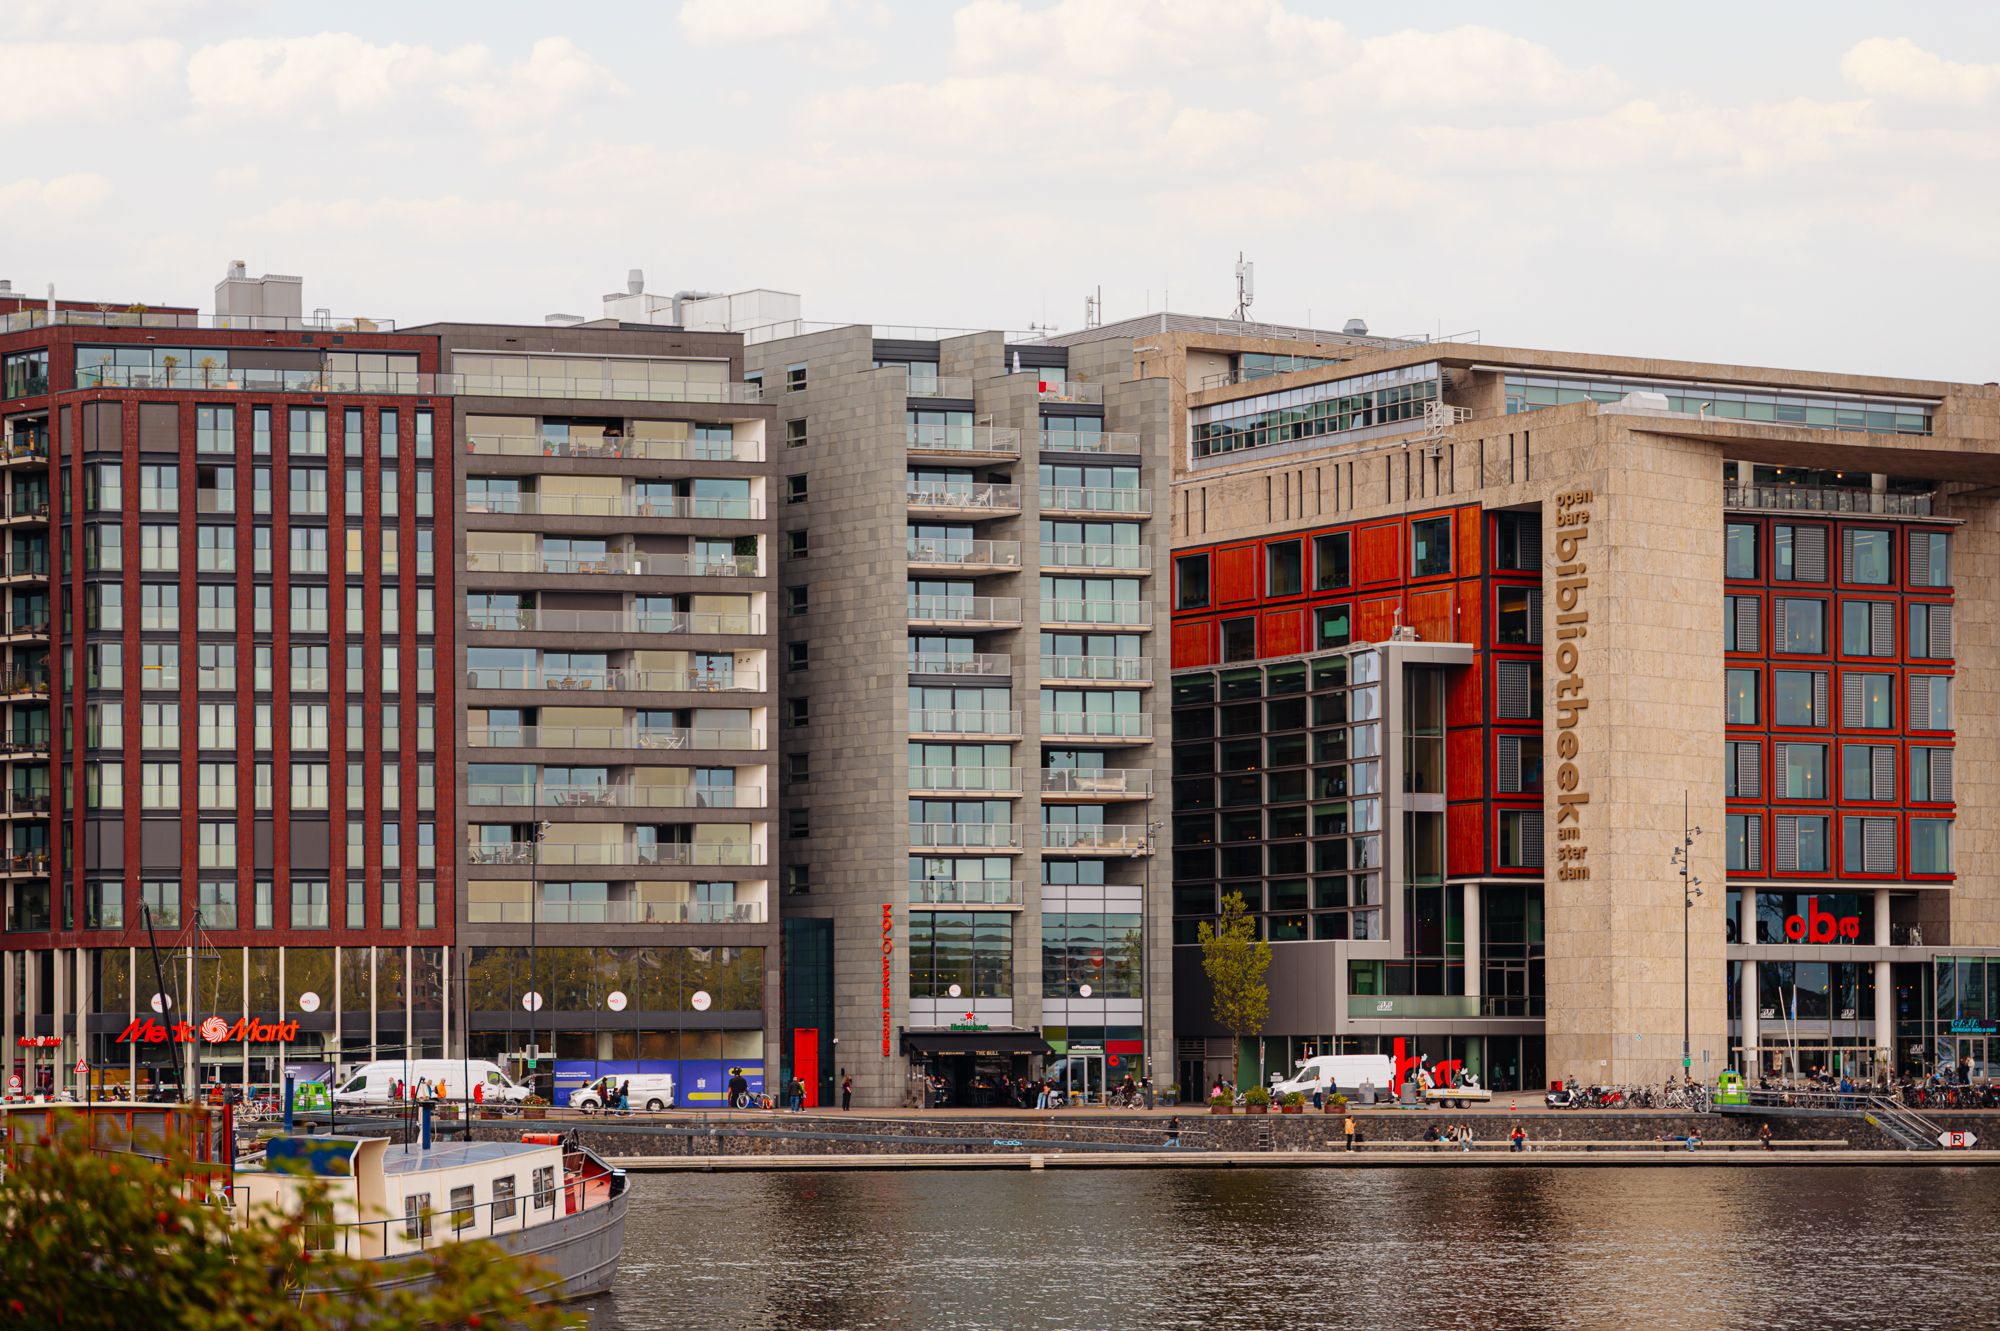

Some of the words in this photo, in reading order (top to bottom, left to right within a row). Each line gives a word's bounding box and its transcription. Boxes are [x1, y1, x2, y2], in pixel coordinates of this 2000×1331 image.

[1556, 490, 1593, 510] open
[1556, 510, 1590, 527] bare
[1556, 528, 1590, 824] bibliotheek
[1557, 827, 1580, 840] am
[1557, 845, 1588, 861] ster
[1557, 862, 1590, 881] dam
[881, 903, 893, 954] MOJO
